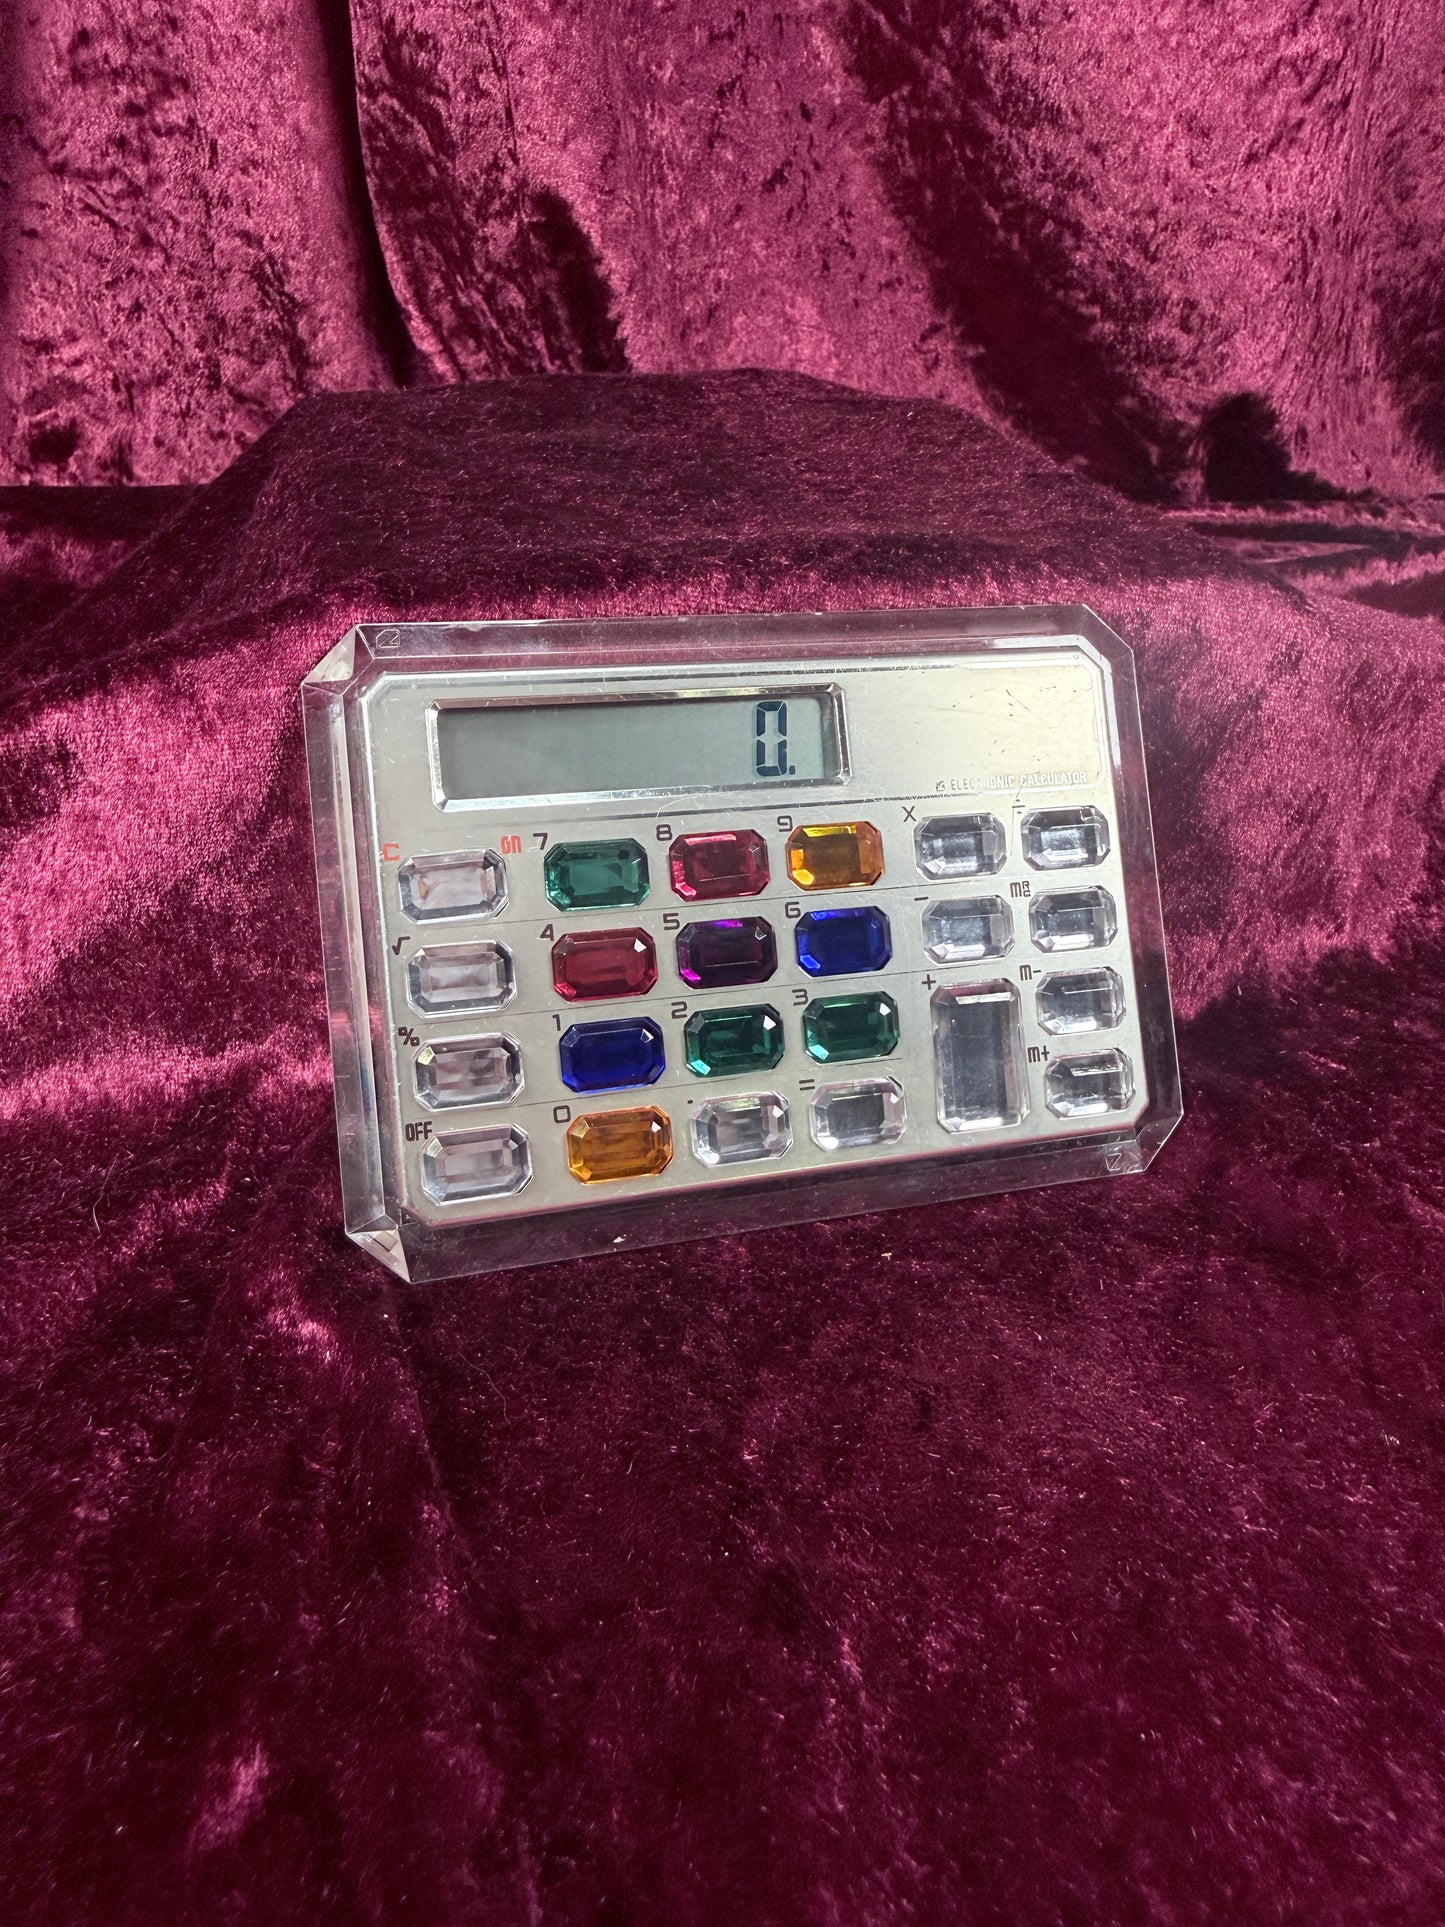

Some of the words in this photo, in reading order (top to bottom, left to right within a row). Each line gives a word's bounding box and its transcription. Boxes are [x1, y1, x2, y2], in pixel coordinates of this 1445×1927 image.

[951, 775, 1016, 791] ELECONIC
[1020, 771, 1088, 787] CALCULATOR
[655, 823, 673, 842] 8
[776, 815, 793, 833] 9
[532, 832, 549, 851] 7
[382, 842, 401, 862] C
[784, 901, 801, 919] 6
[662, 912, 681, 931] 5
[540, 923, 555, 942] 4
[791, 988, 809, 1006] 3
[671, 1000, 688, 1019] 2
[552, 1014, 562, 1032] 1
[397, 1026, 420, 1047] %
[553, 1105, 572, 1124] 0
[405, 1120, 433, 1142] OFF
